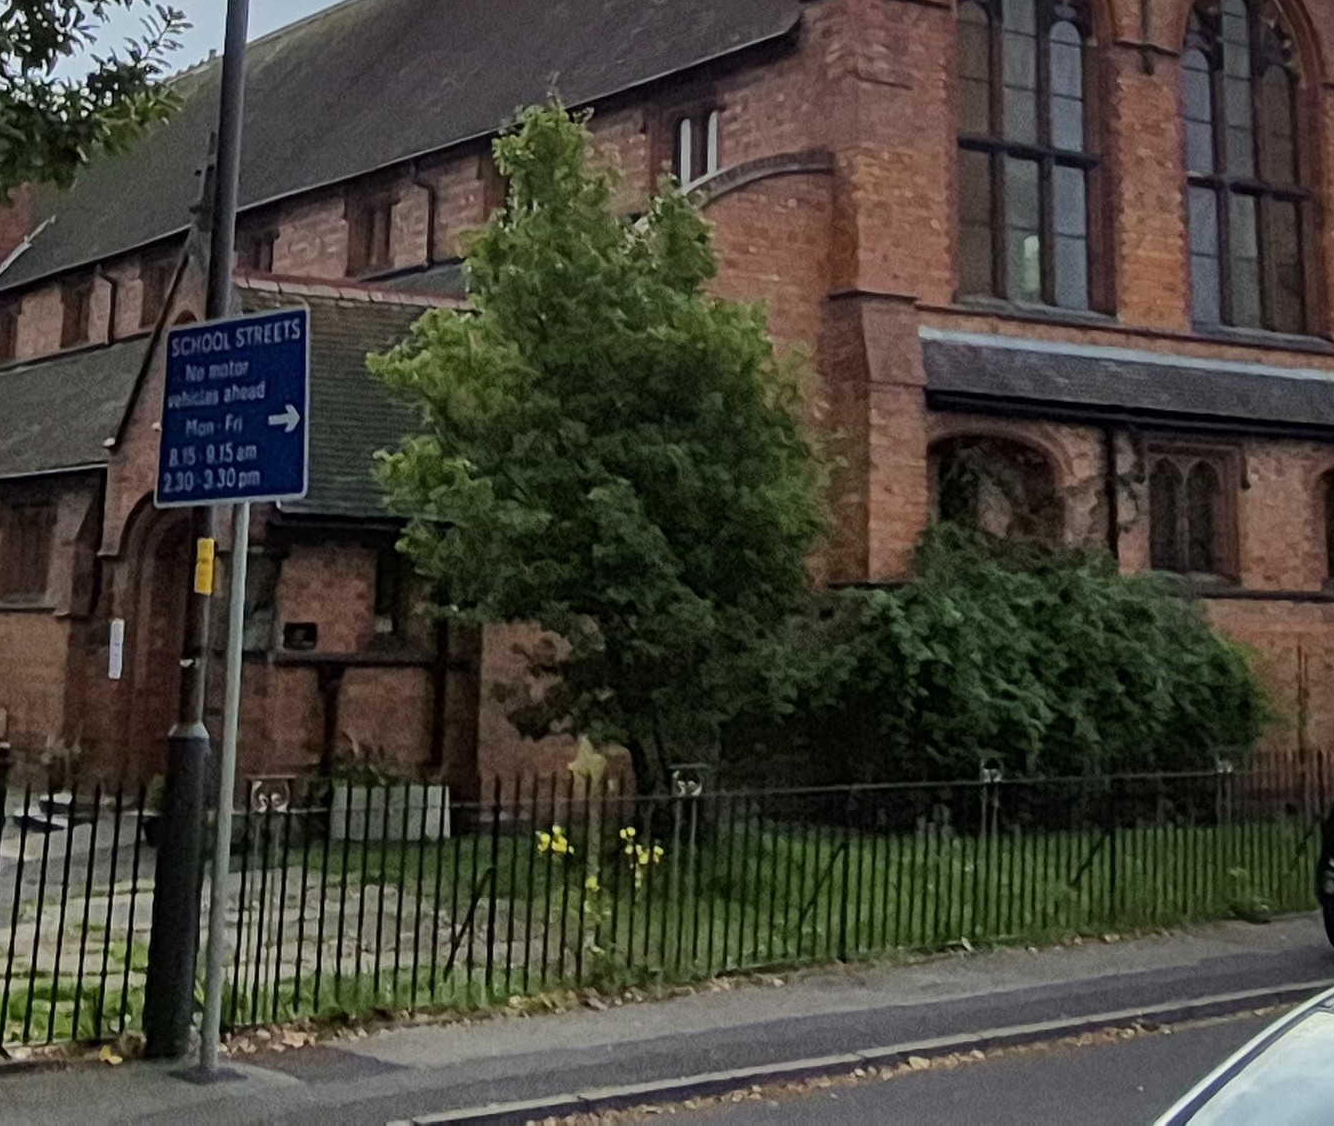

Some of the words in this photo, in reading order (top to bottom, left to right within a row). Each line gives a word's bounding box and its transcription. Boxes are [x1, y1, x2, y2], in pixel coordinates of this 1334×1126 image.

[171, 331, 231, 358] SCHOOL
[235, 318, 300, 348] STREETS
[185, 364, 205, 382] No
[208, 360, 249, 379] motor
[224, 381, 266, 402] ahead
[185, 418, 215, 437] Mon
[225, 413, 243, 432] Fri
[236, 445, 257, 462] am
[238, 470, 261, 489] pm
